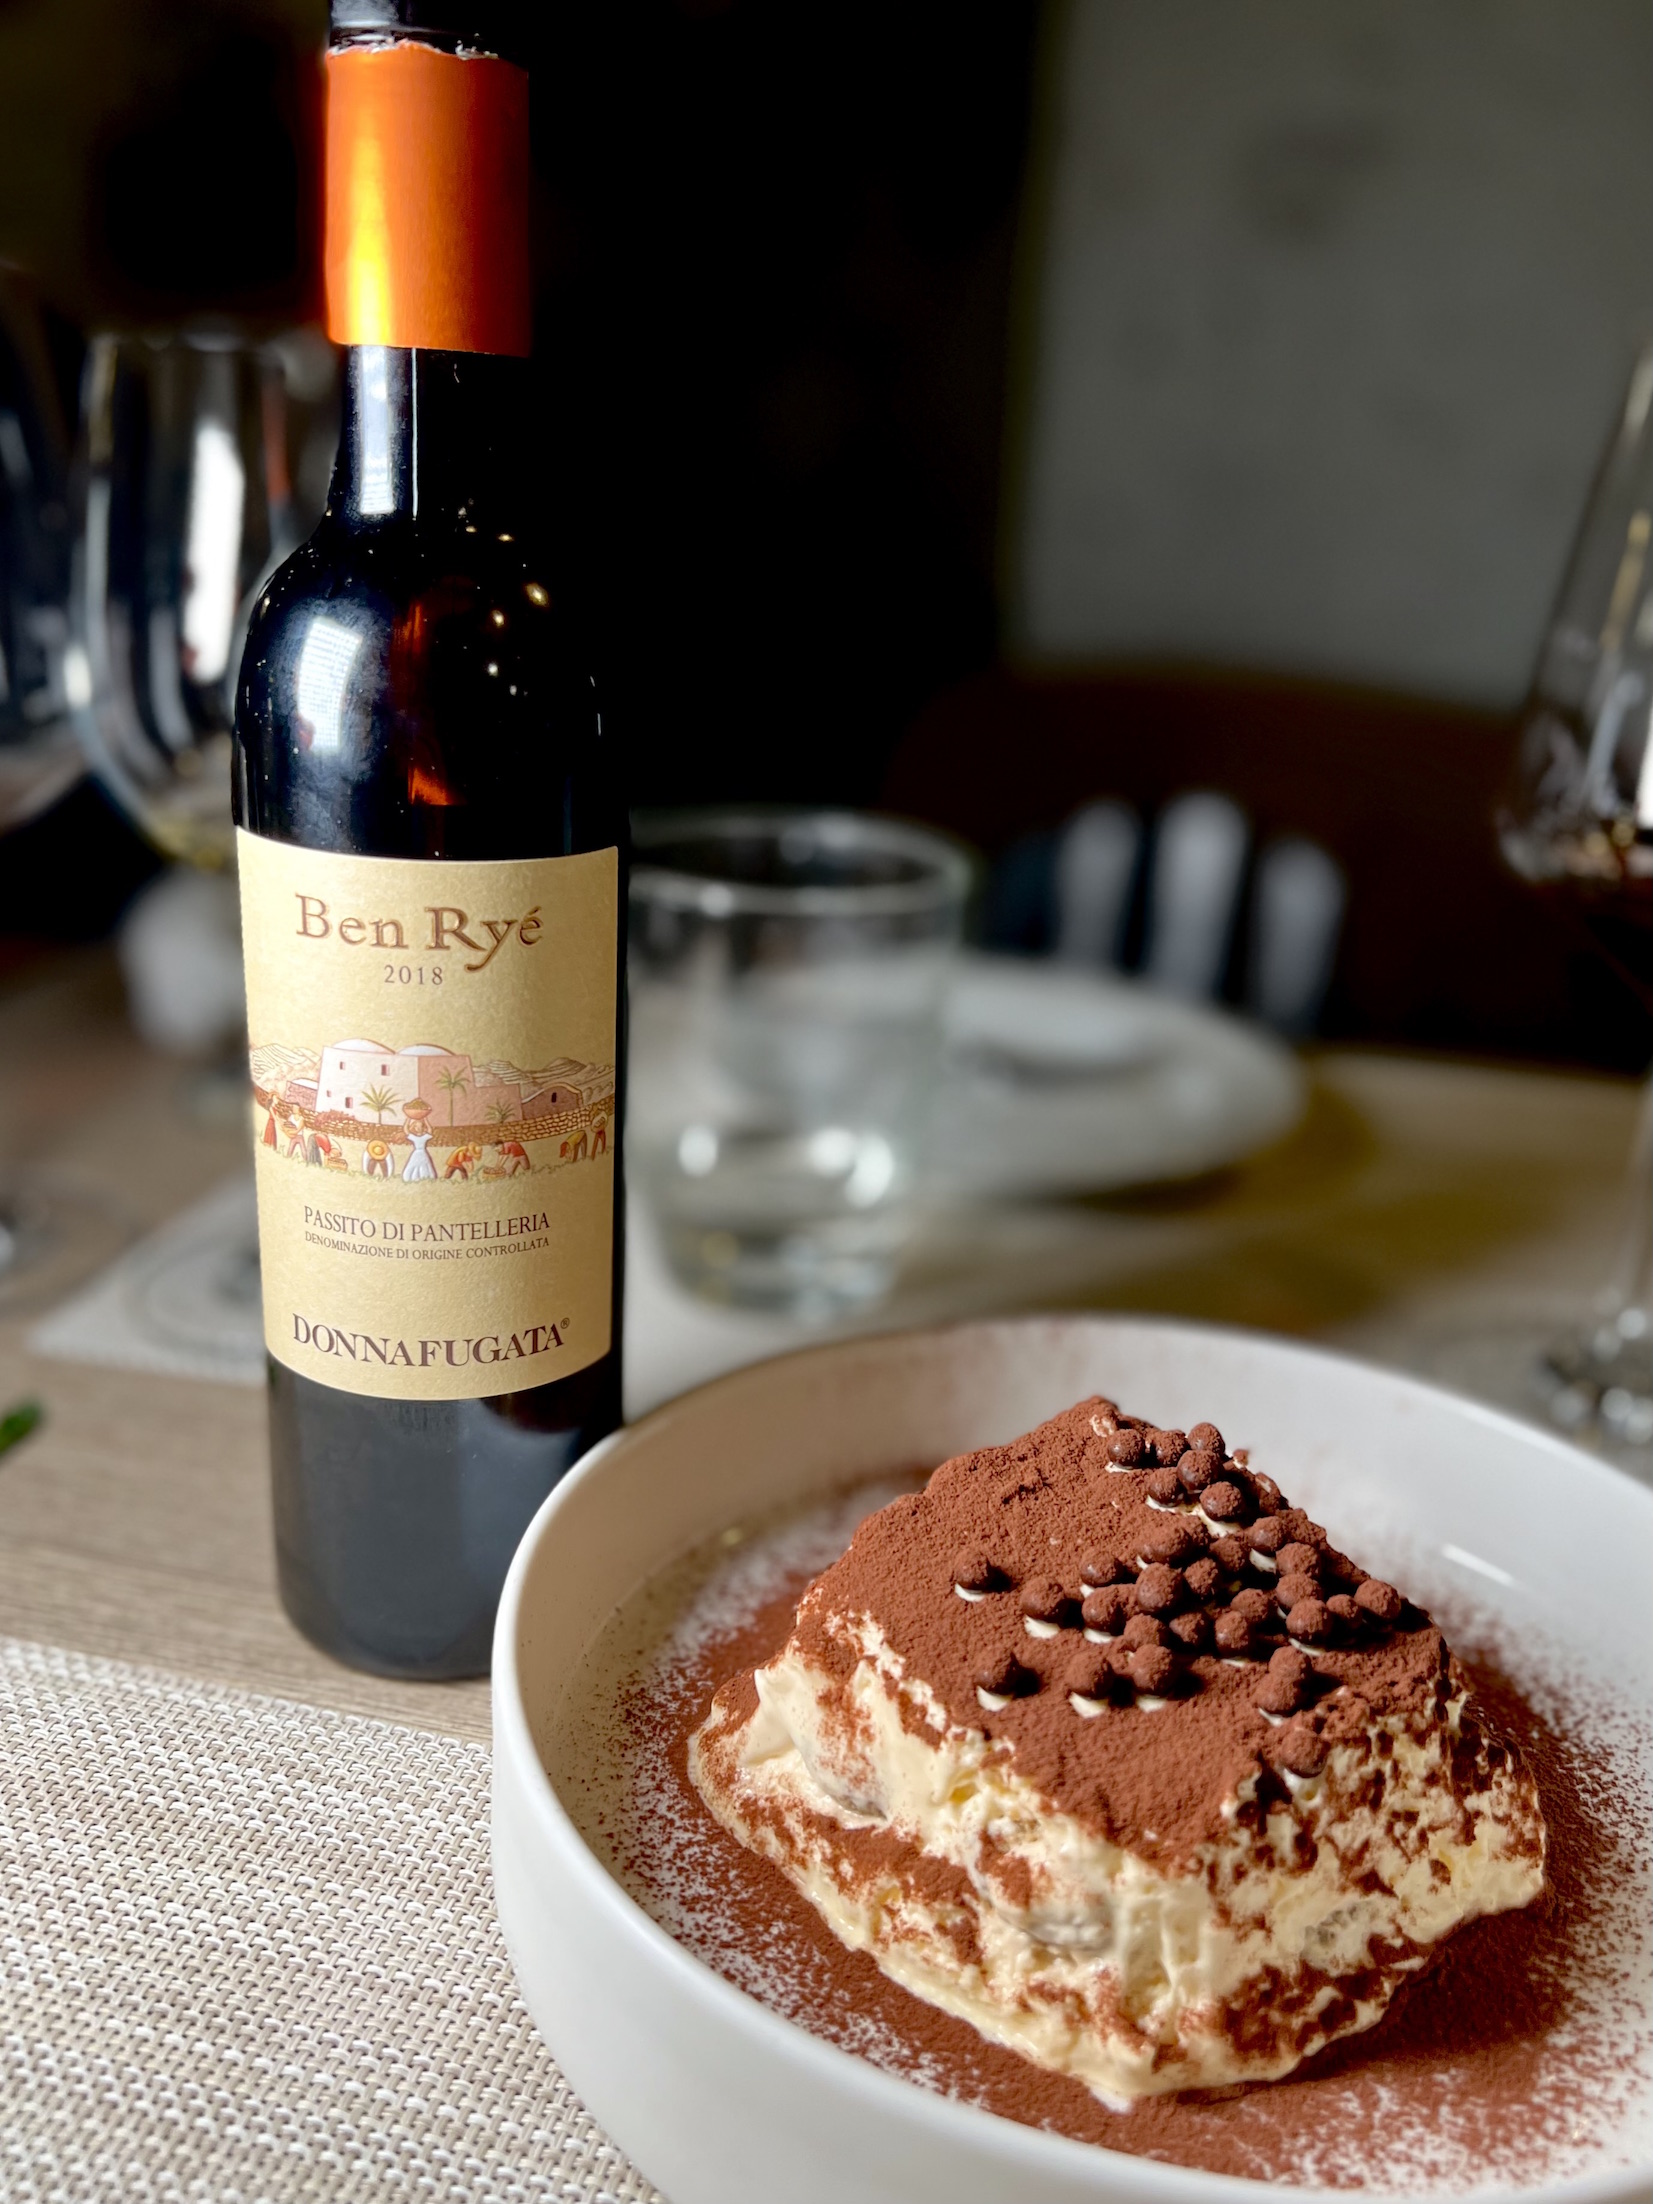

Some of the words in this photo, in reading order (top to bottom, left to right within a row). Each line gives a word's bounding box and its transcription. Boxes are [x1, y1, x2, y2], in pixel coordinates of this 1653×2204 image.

[295, 893, 408, 948] Ben
[424, 905, 544, 971] Ryé
[384, 964, 444, 985] 2018
[304, 1206, 375, 1238] PASSITO
[382, 1223, 404, 1241] DI
[411, 1213, 551, 1242] PANTELLERIA
[304, 1232, 393, 1259] DENOMINAZIONE
[396, 1249, 409, 1258] DI
[412, 1249, 463, 1259] ORIGINE
[466, 1237, 550, 1259] CONTROLLATA
